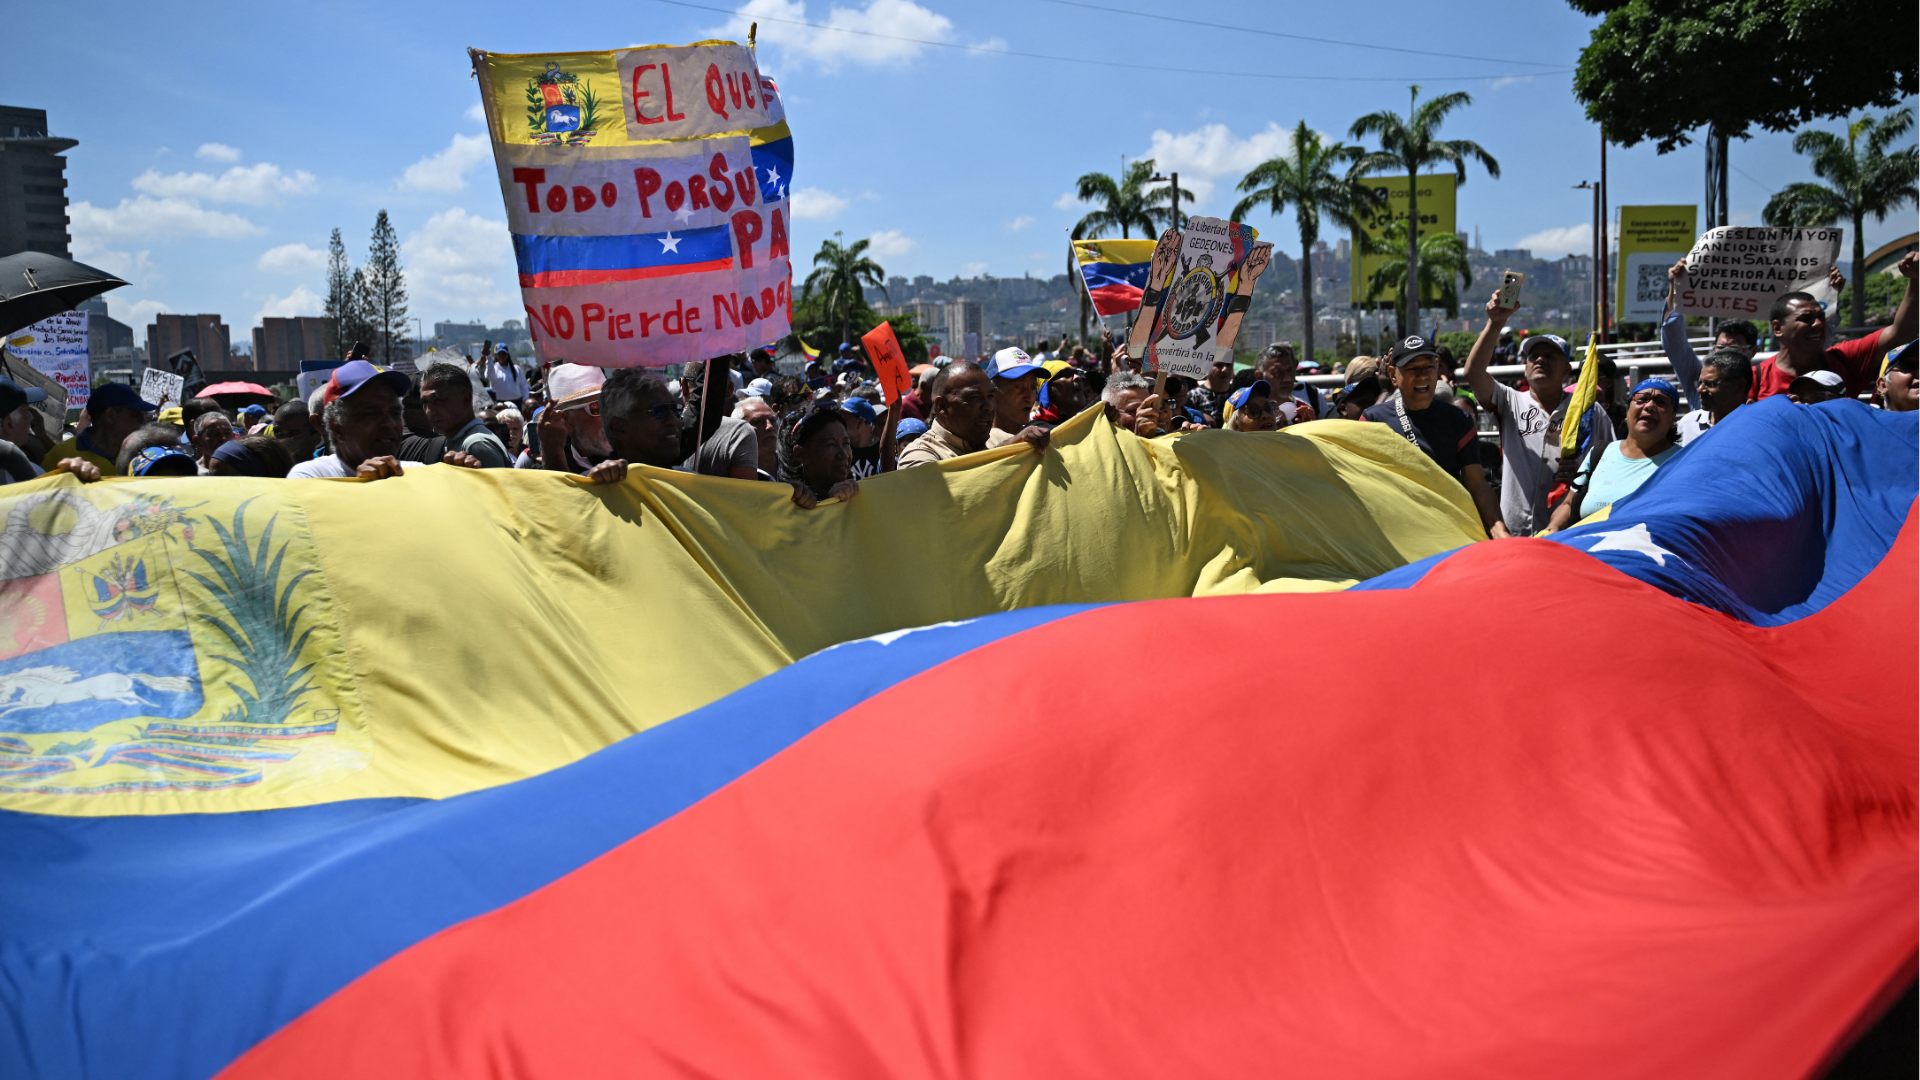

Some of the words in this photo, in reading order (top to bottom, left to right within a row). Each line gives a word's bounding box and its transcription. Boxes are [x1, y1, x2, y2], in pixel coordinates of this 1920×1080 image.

[632, 63, 685, 125] EL
[731, 202, 790, 270] PA
[1195, 221, 1228, 237] Libertad
[1781, 227, 1839, 242] MAYOR
[1693, 242, 1777, 253] SANCIONES
[1691, 252, 1741, 265] TIENEN
[1743, 253, 1818, 266] SALARIOS
[1688, 265, 1763, 280] SUPERIOR
[1689, 277, 1776, 293] VENEZUELA
[525, 304, 575, 342] NO
[581, 299, 702, 342] Pierde
